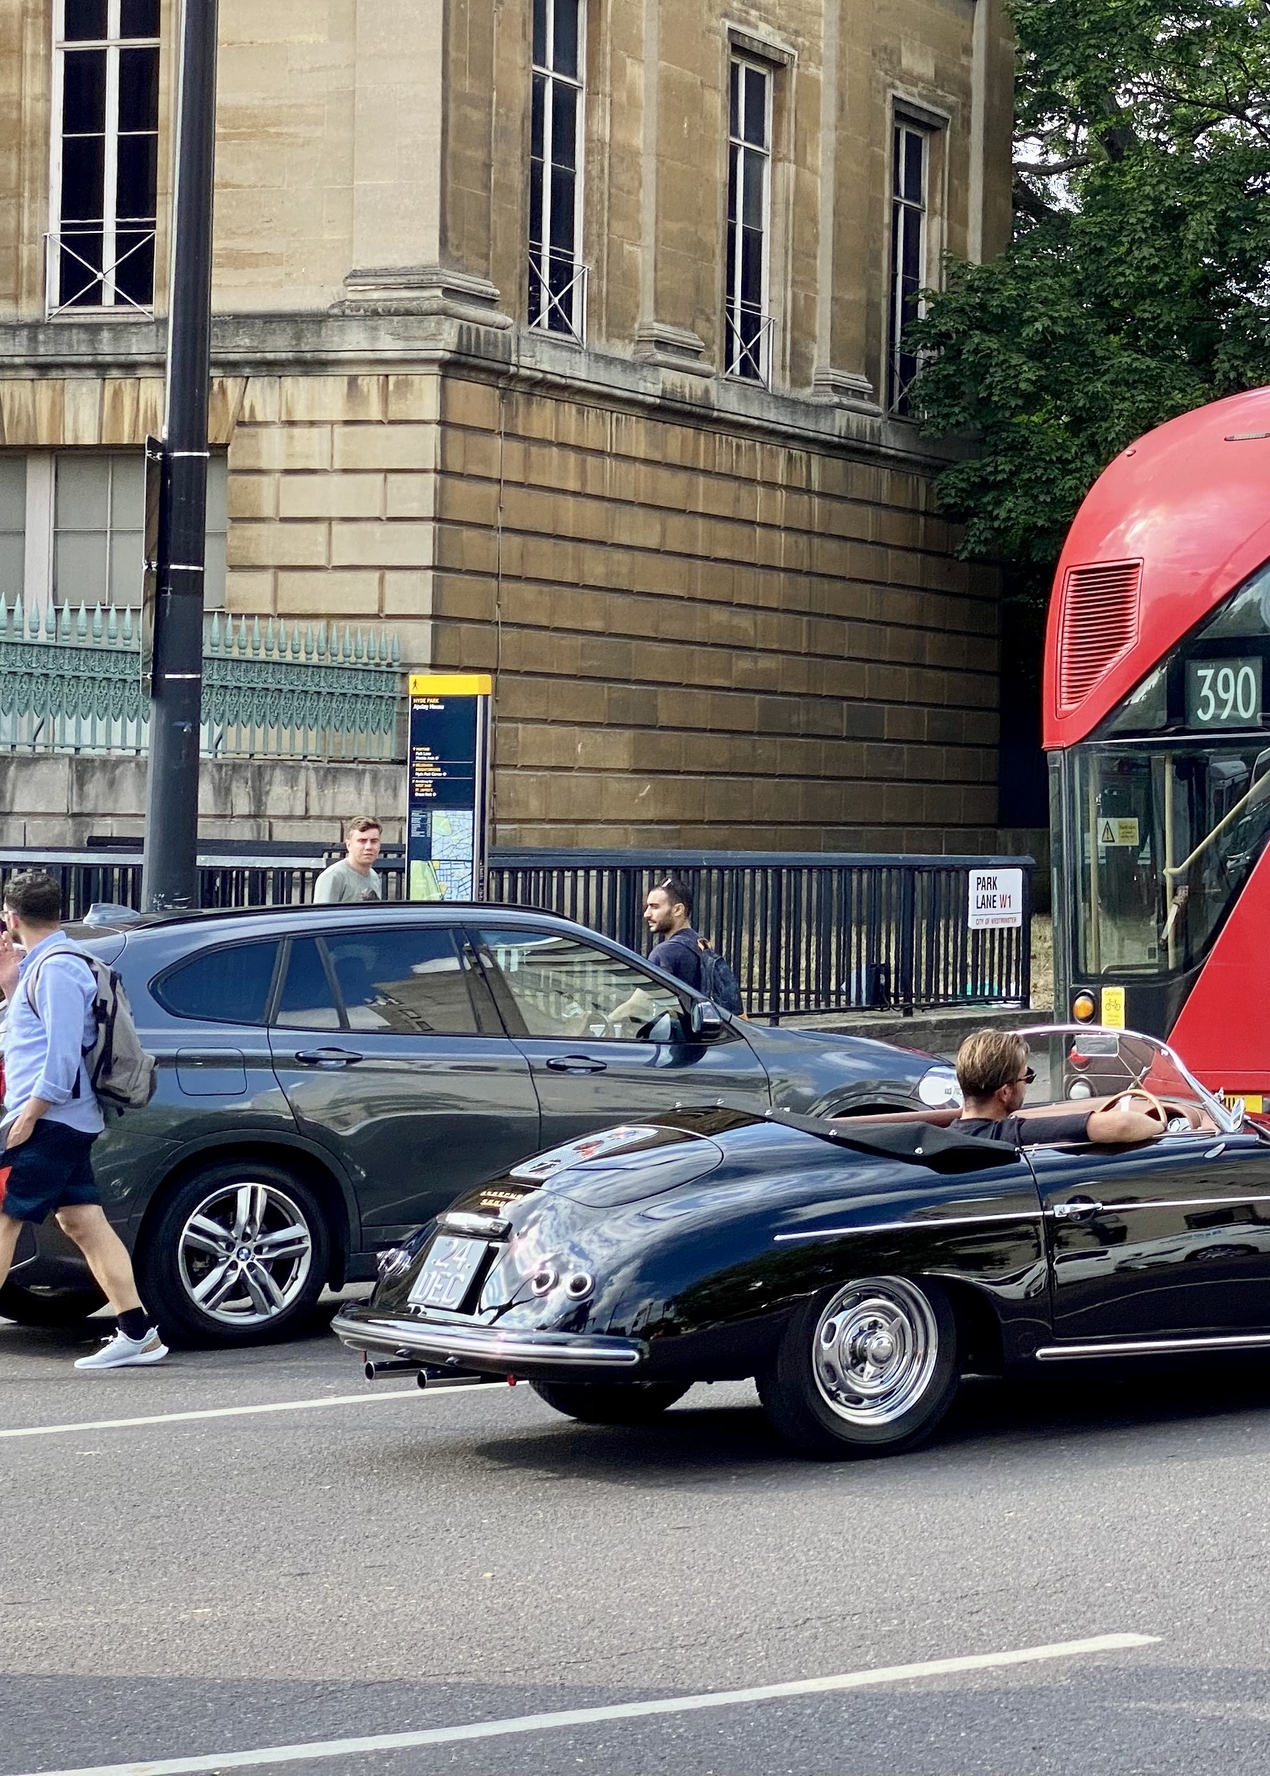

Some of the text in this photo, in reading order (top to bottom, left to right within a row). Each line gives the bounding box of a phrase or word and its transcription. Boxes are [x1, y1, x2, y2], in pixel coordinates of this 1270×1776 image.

[1196, 665, 1257, 721] 390
[976, 876, 998, 891] PARK
[976, 894, 1012, 909] LANE W1
[975, 918, 984, 926] CITY
[991, 916, 1017, 925] WESTMINSTER
[434, 1239, 475, 1270] 24
[413, 1271, 466, 1306] DEC
